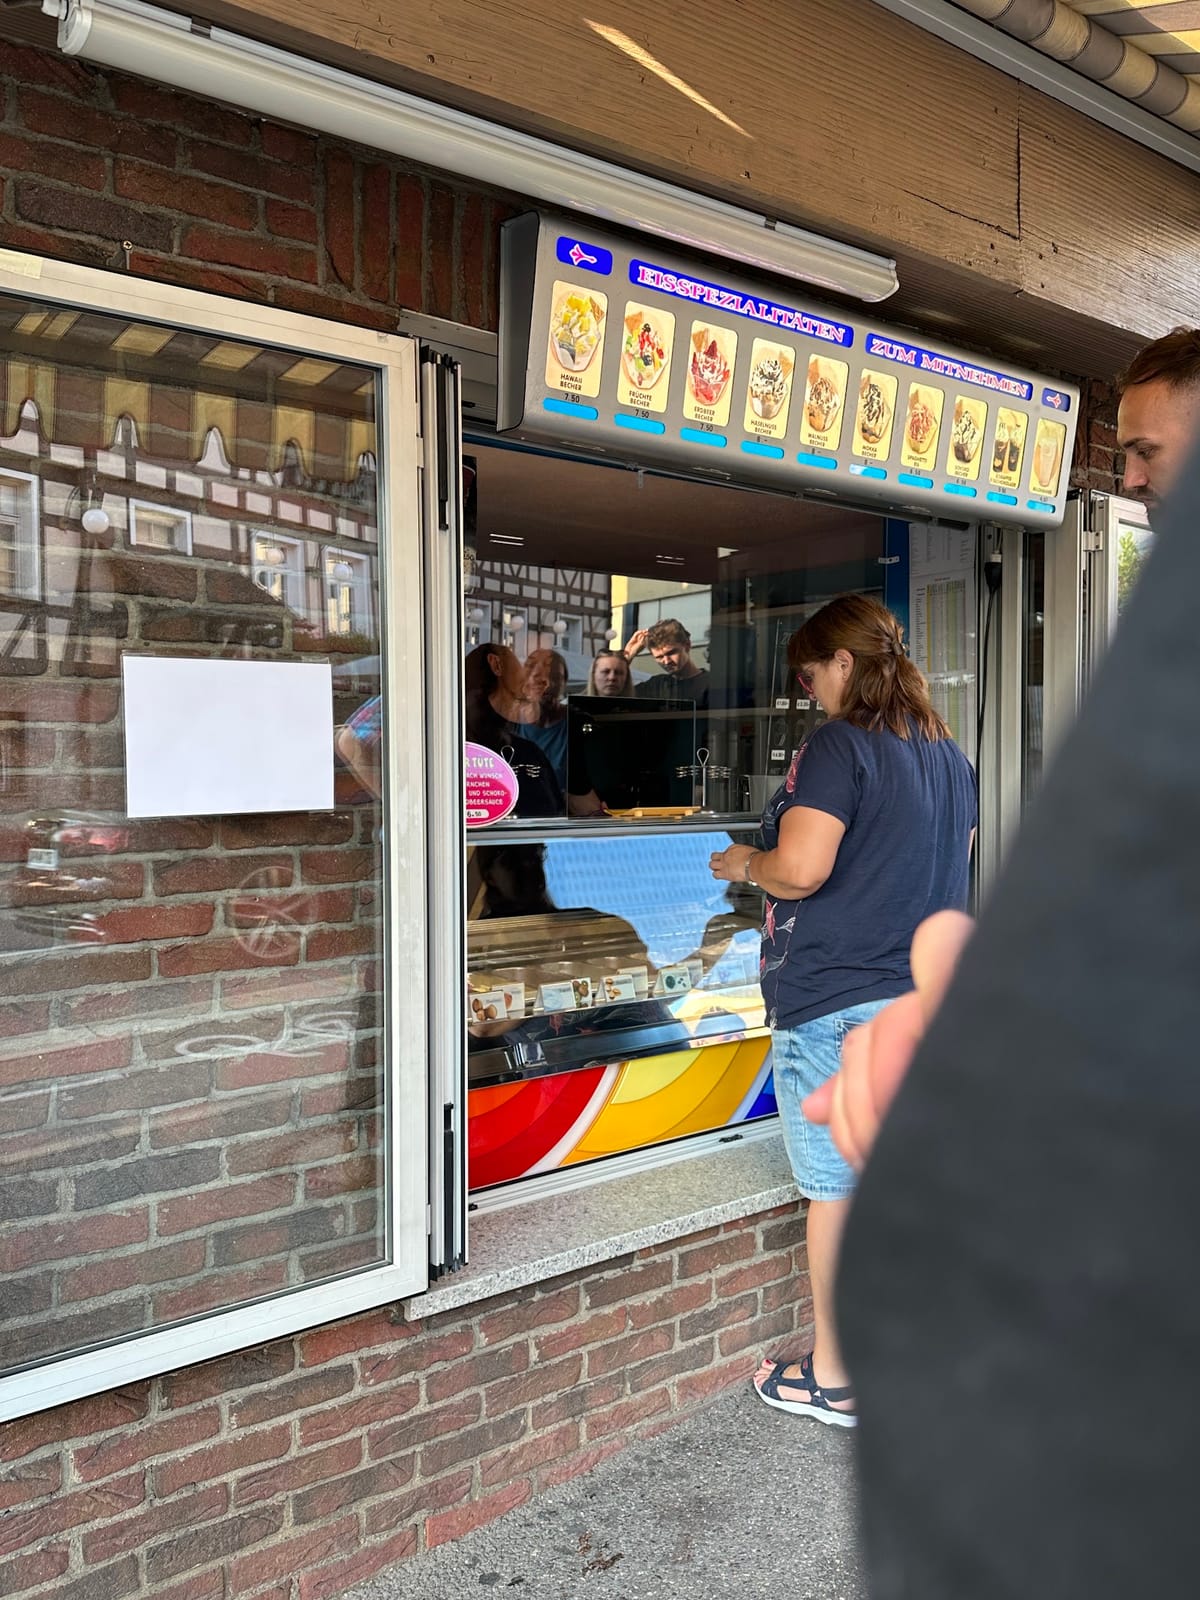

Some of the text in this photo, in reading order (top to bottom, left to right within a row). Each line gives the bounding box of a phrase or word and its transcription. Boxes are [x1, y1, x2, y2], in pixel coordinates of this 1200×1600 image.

[637, 265, 1028, 398] EISSPEZIALITÄTEN ZUM MITNEHMEN
[560, 380, 582, 391] BECHER
[630, 398, 650, 408] BECHER
[694, 413, 713, 422] BECHER
[754, 427, 772, 435] BECHER
[809, 439, 825, 447] BECHER
